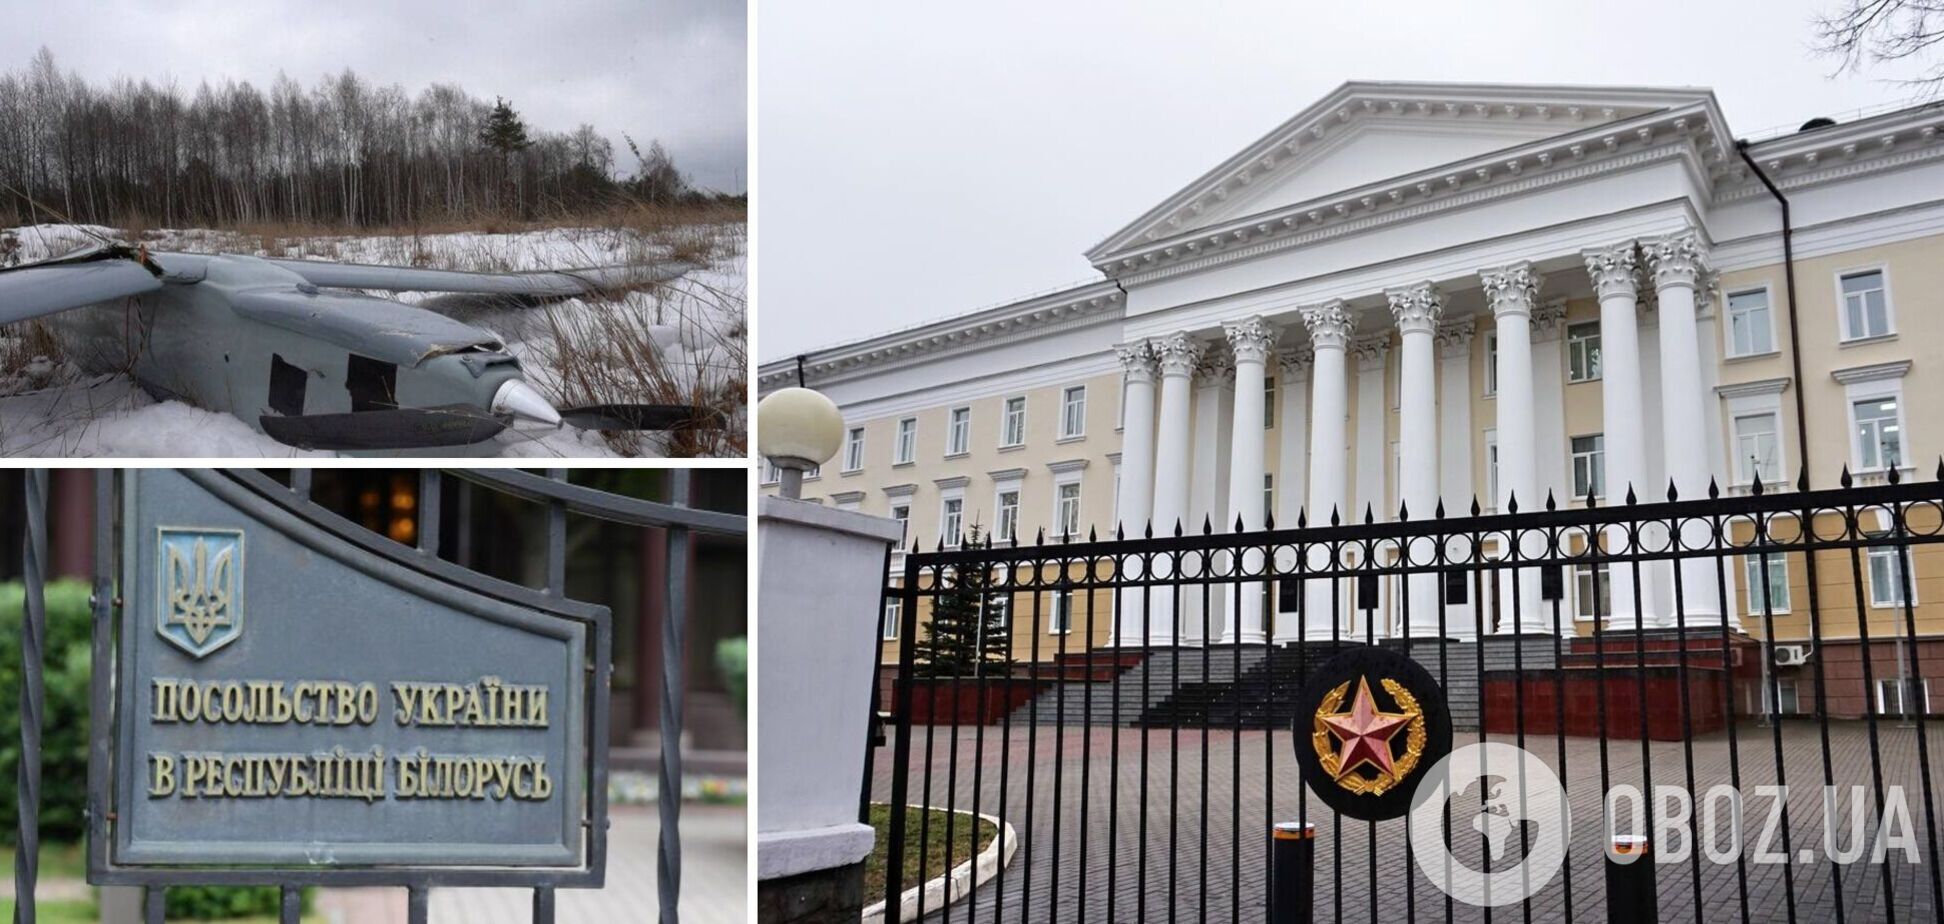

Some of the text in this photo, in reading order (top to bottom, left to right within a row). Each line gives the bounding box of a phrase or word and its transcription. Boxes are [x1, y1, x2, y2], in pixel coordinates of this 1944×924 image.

[151, 676, 549, 727] ПОСОЛЬСТВО УКРАЇНИ
[149, 745, 552, 802] В РЕСПУБЛІЦІ БІЛОРУСЬ
